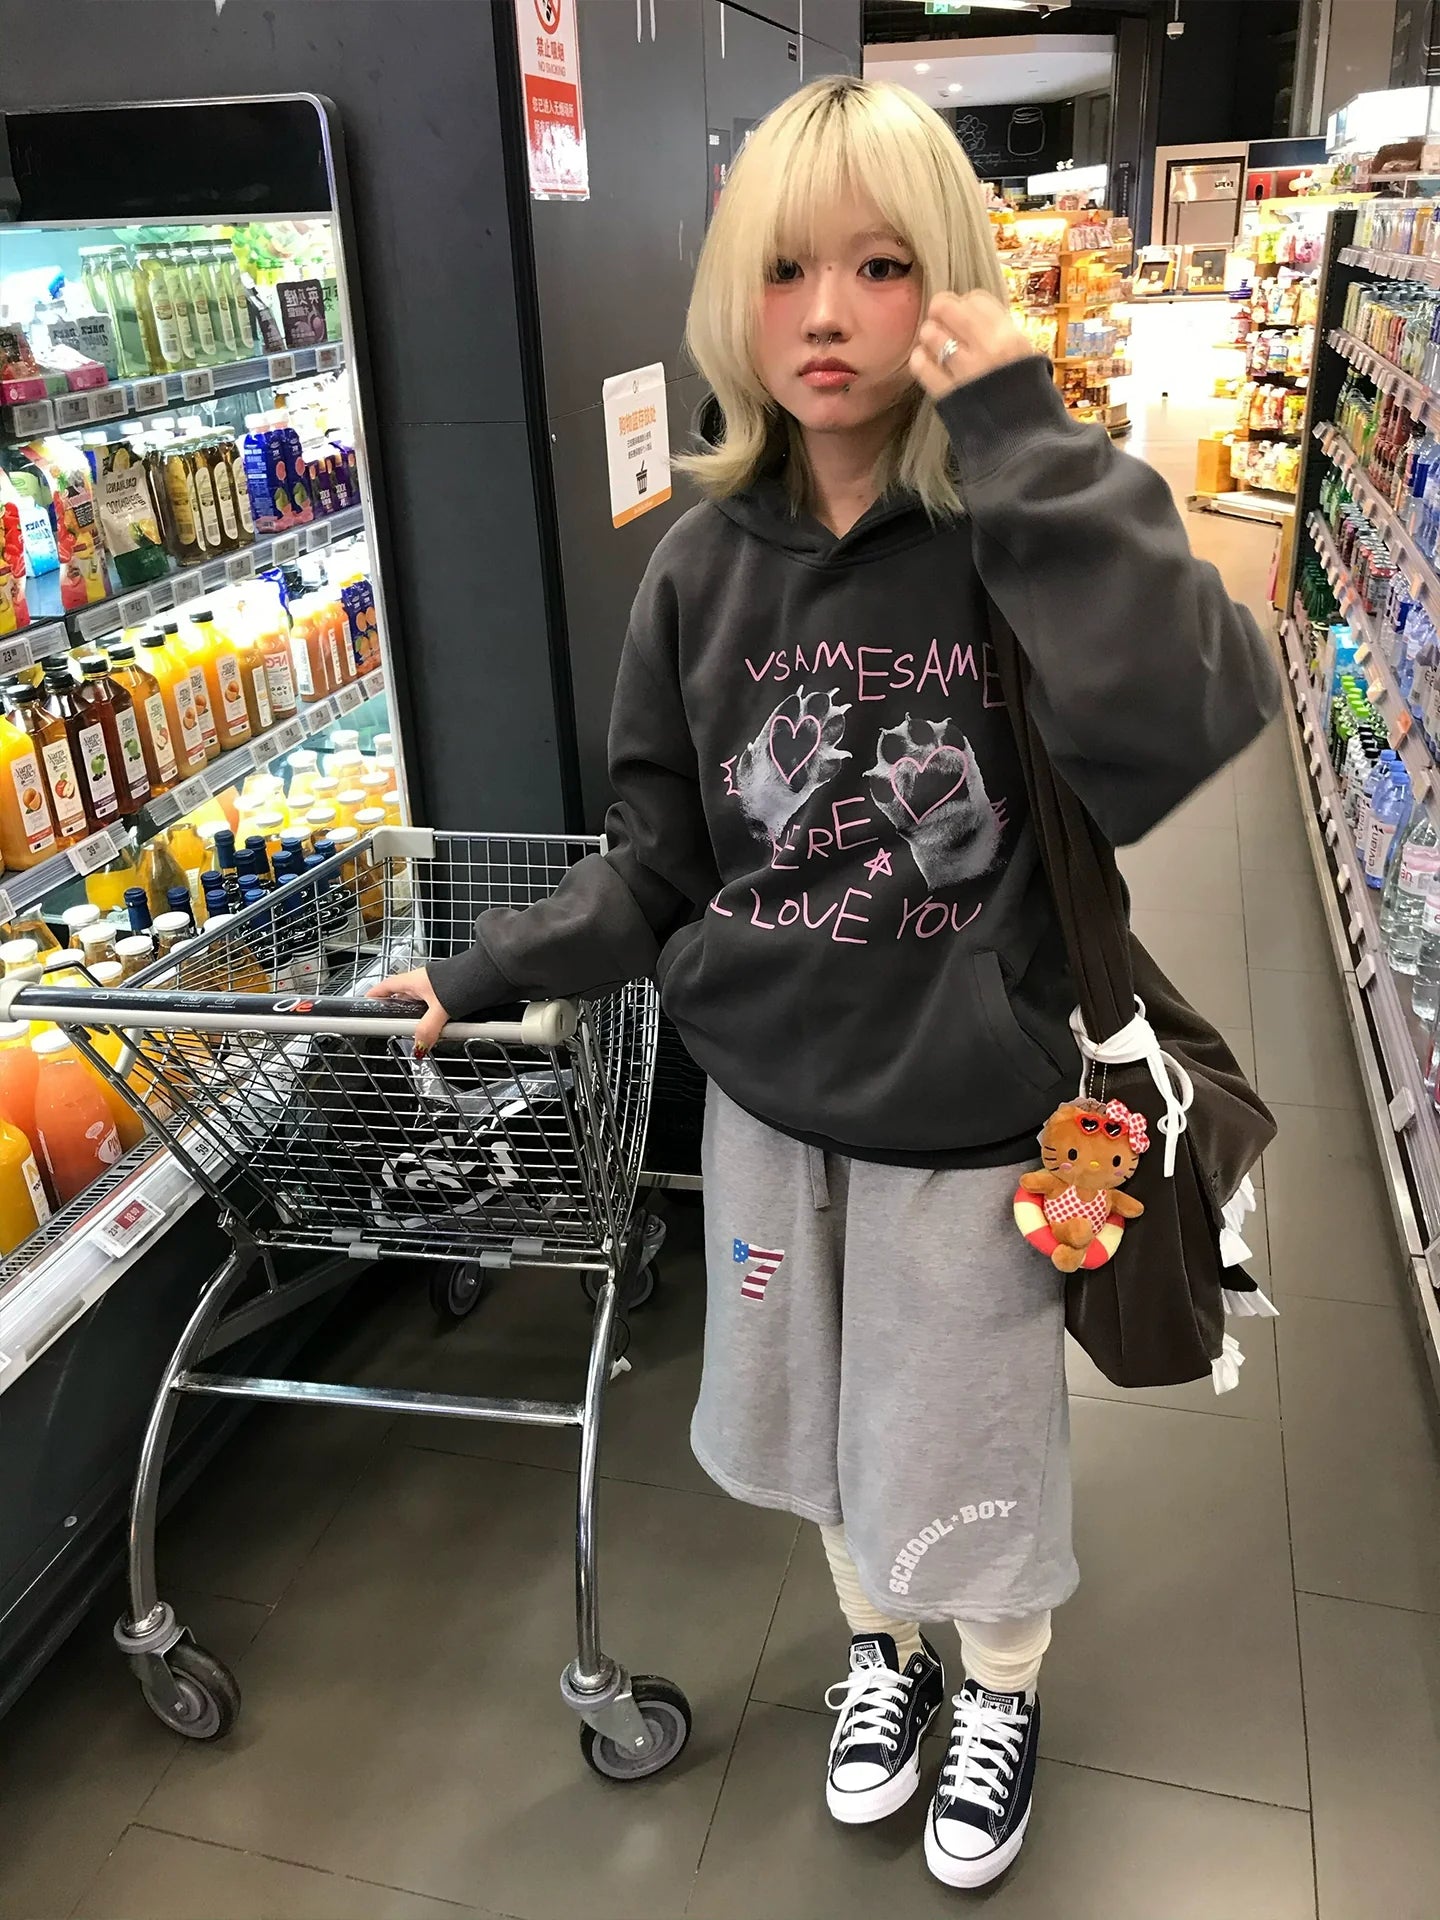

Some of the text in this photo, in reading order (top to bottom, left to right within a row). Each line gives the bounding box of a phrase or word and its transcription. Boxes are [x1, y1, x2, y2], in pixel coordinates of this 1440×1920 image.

[1368, 831, 1379, 867] evian
[750, 887, 873, 945] LOVE
[897, 895, 983, 940] YOU
[888, 1500, 1018, 1596] SCHOOL BOY
[984, 1694, 1012, 1704] CONVERSE
